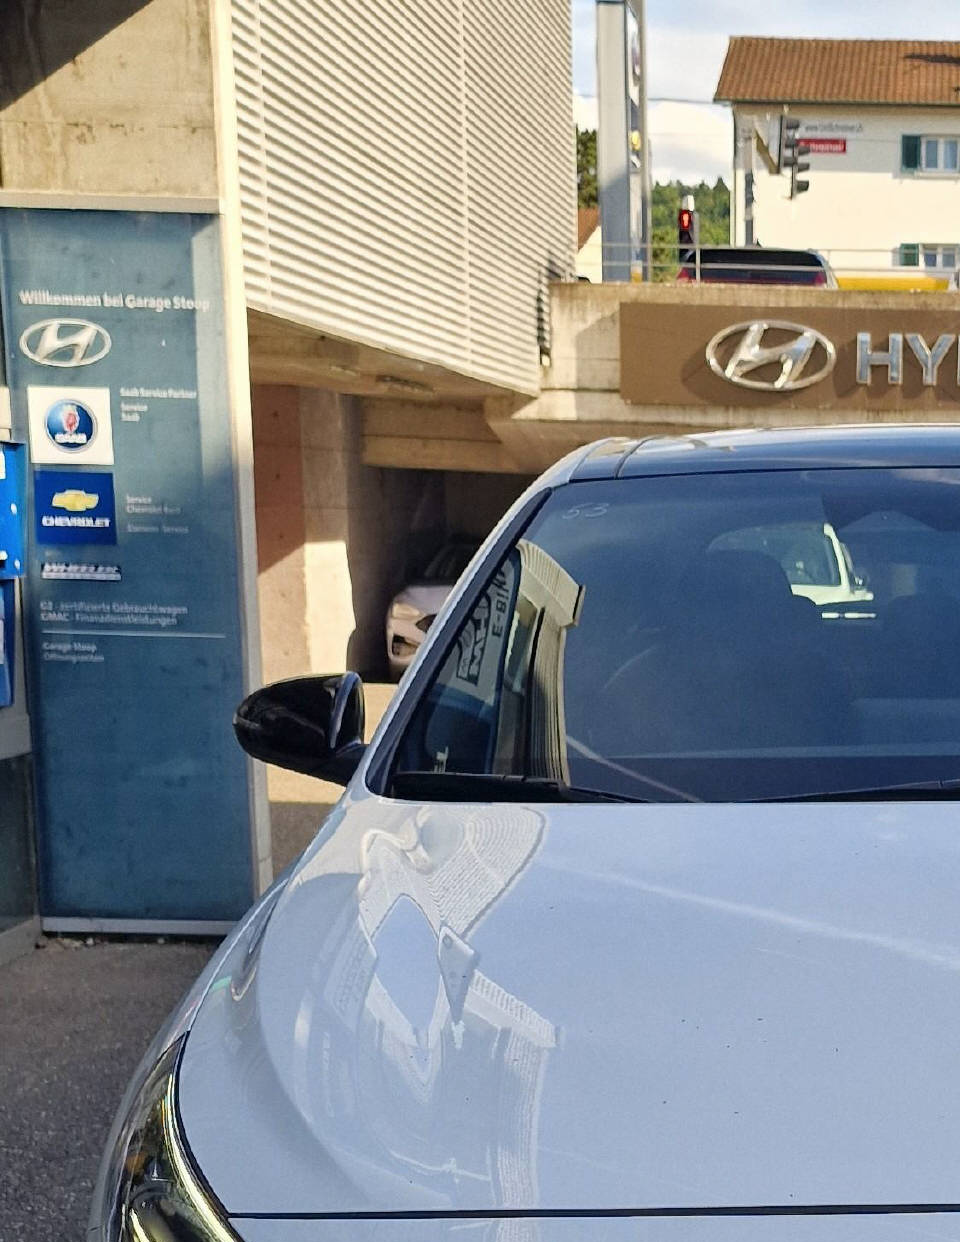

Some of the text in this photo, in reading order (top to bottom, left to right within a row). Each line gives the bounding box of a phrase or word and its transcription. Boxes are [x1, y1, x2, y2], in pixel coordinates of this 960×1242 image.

[19, 290, 210, 313] Willkommen bei Garage Stoop
[42, 515, 110, 528] CHEVROLET
